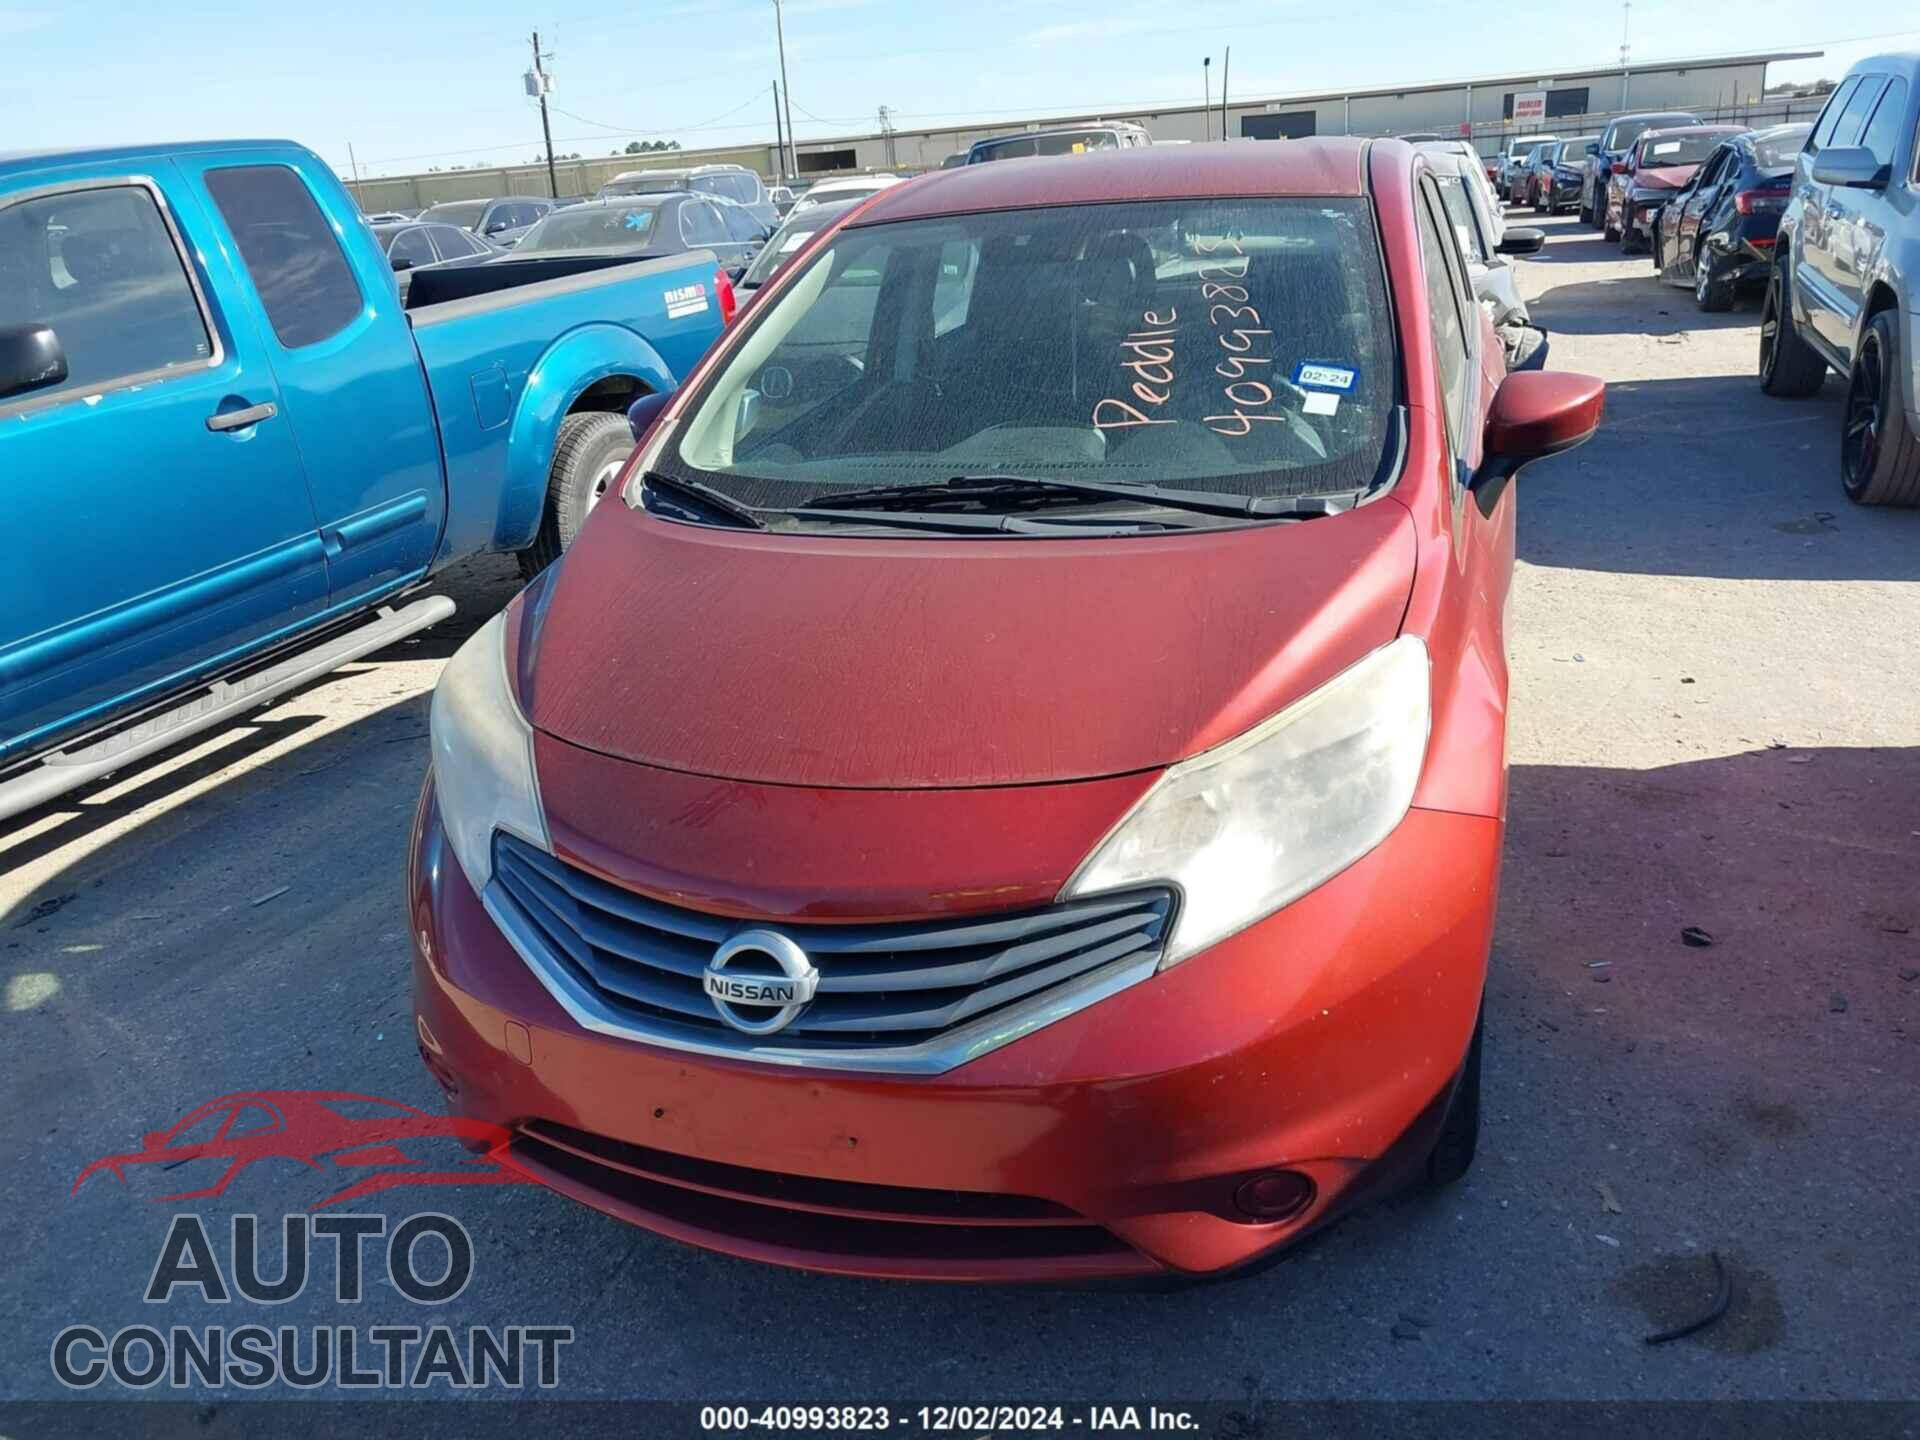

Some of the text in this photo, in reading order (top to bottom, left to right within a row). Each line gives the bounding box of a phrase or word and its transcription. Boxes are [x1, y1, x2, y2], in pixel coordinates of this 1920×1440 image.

[1092, 306, 1177, 428] Peddle
[1194, 238, 1286, 436] 40993823
[709, 977, 794, 1001] NISSAN
